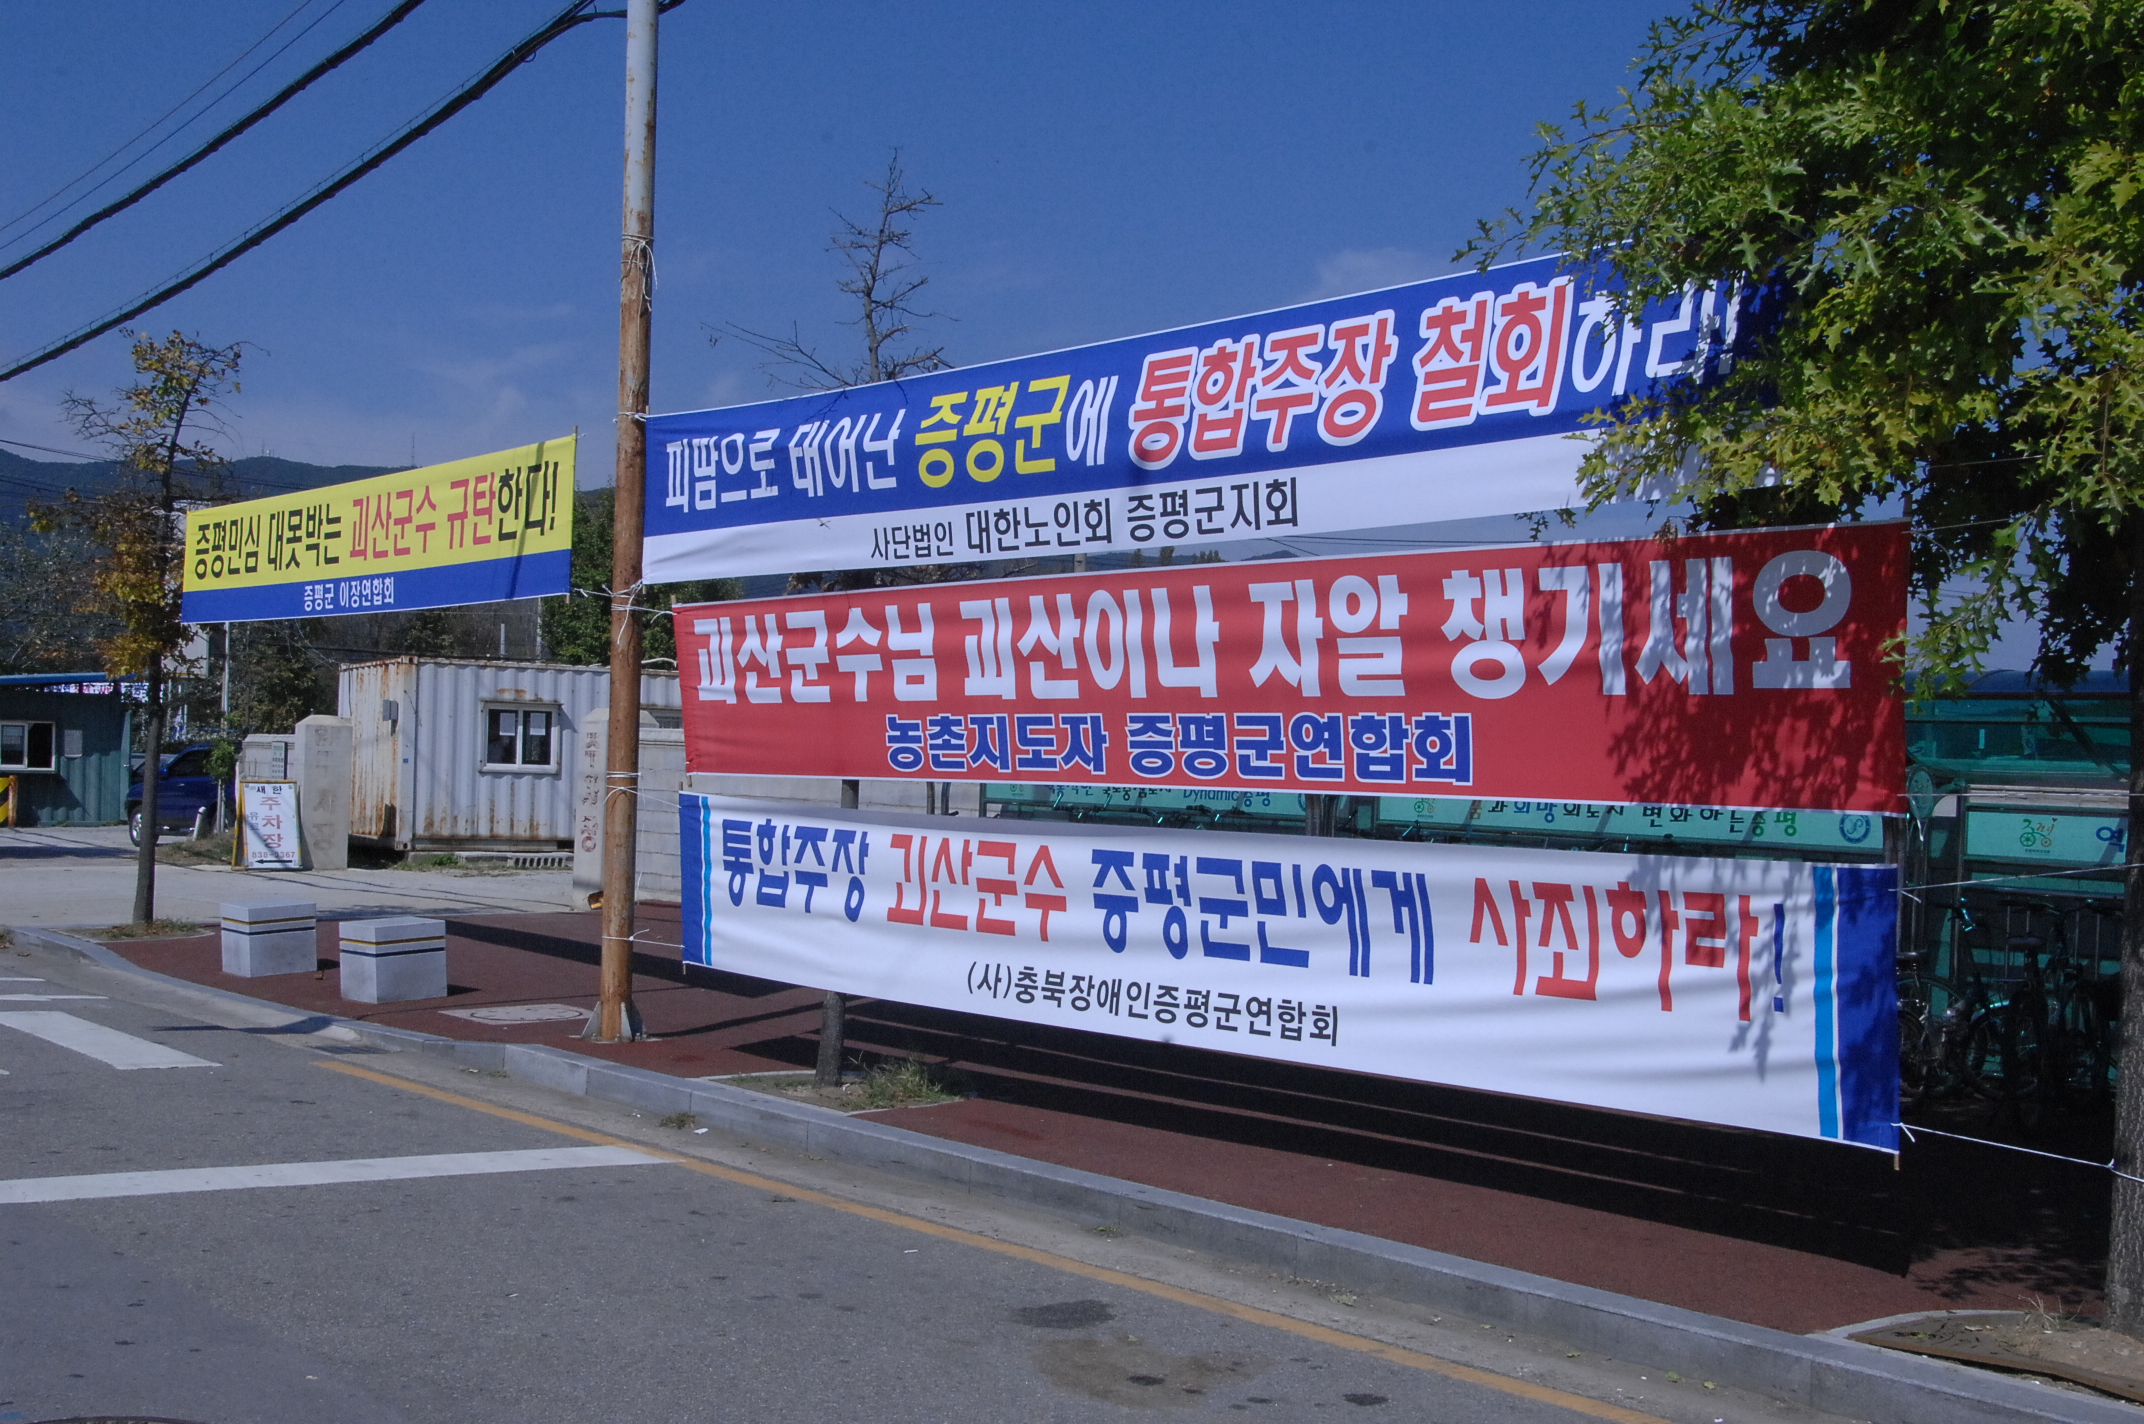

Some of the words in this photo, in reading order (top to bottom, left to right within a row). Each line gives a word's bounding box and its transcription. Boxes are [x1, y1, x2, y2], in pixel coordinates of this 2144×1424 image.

[665, 428, 780, 513] 피땀으로
[788, 409, 906, 498] 태어난
[915, 374, 1119, 489] 증평군에
[1127, 308, 1396, 471] 통합주장
[194, 513, 260, 580] 증평민심
[267, 502, 342, 572] 대못박는
[350, 485, 437, 561] 괴산군수
[447, 460, 559, 550] 규탄한다!
[871, 526, 954, 562] 사단법인
[965, 506, 1113, 556] 대한노인회
[1127, 476, 1299, 543] 증평군지회
[304, 582, 334, 612] 증평군
[339, 576, 395, 609] 이장연합회
[693, 602, 938, 705] 괴산군수님
[959, 584, 1220, 700] 괴산이나
[1248, 573, 1408, 698] 자알
[1441, 549, 1852, 700] 챙기세요
[886, 713, 1108, 775] 농촌지도자
[1125, 712, 1473, 787] 증평군연합회
[260, 796, 283, 849] 주차장
[722, 818, 869, 923] 통합주장
[887, 833, 1068, 943] 괴산군수
[1091, 848, 1434, 985] 증평군민에게
[1469, 876, 1785, 1023] 사죄하라!
[967, 961, 1339, 1047] (사)충북장애인증평군연합회
